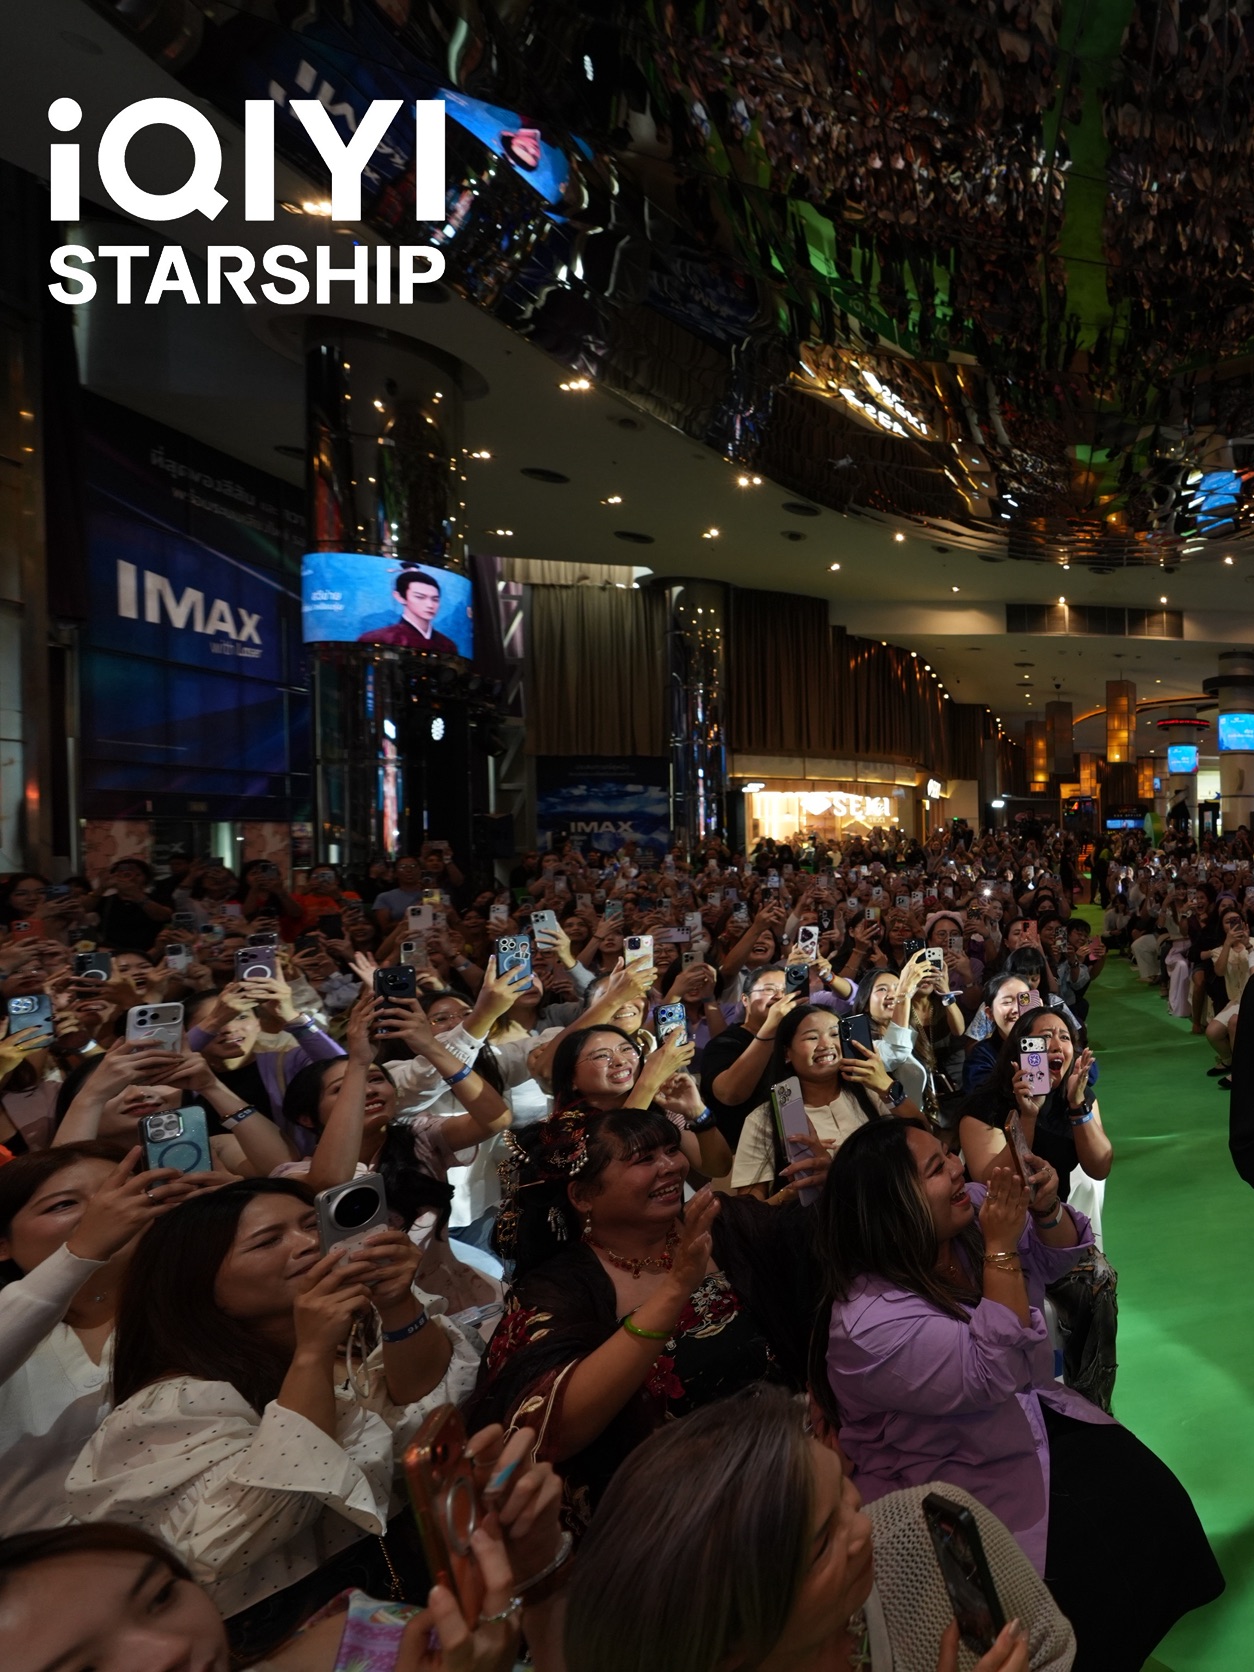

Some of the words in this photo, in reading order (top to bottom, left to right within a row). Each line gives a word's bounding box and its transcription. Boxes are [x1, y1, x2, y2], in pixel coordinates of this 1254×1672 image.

[116, 558, 263, 645] IMAX
[833, 796, 891, 817] SEKI
[570, 821, 634, 833] IMAX
